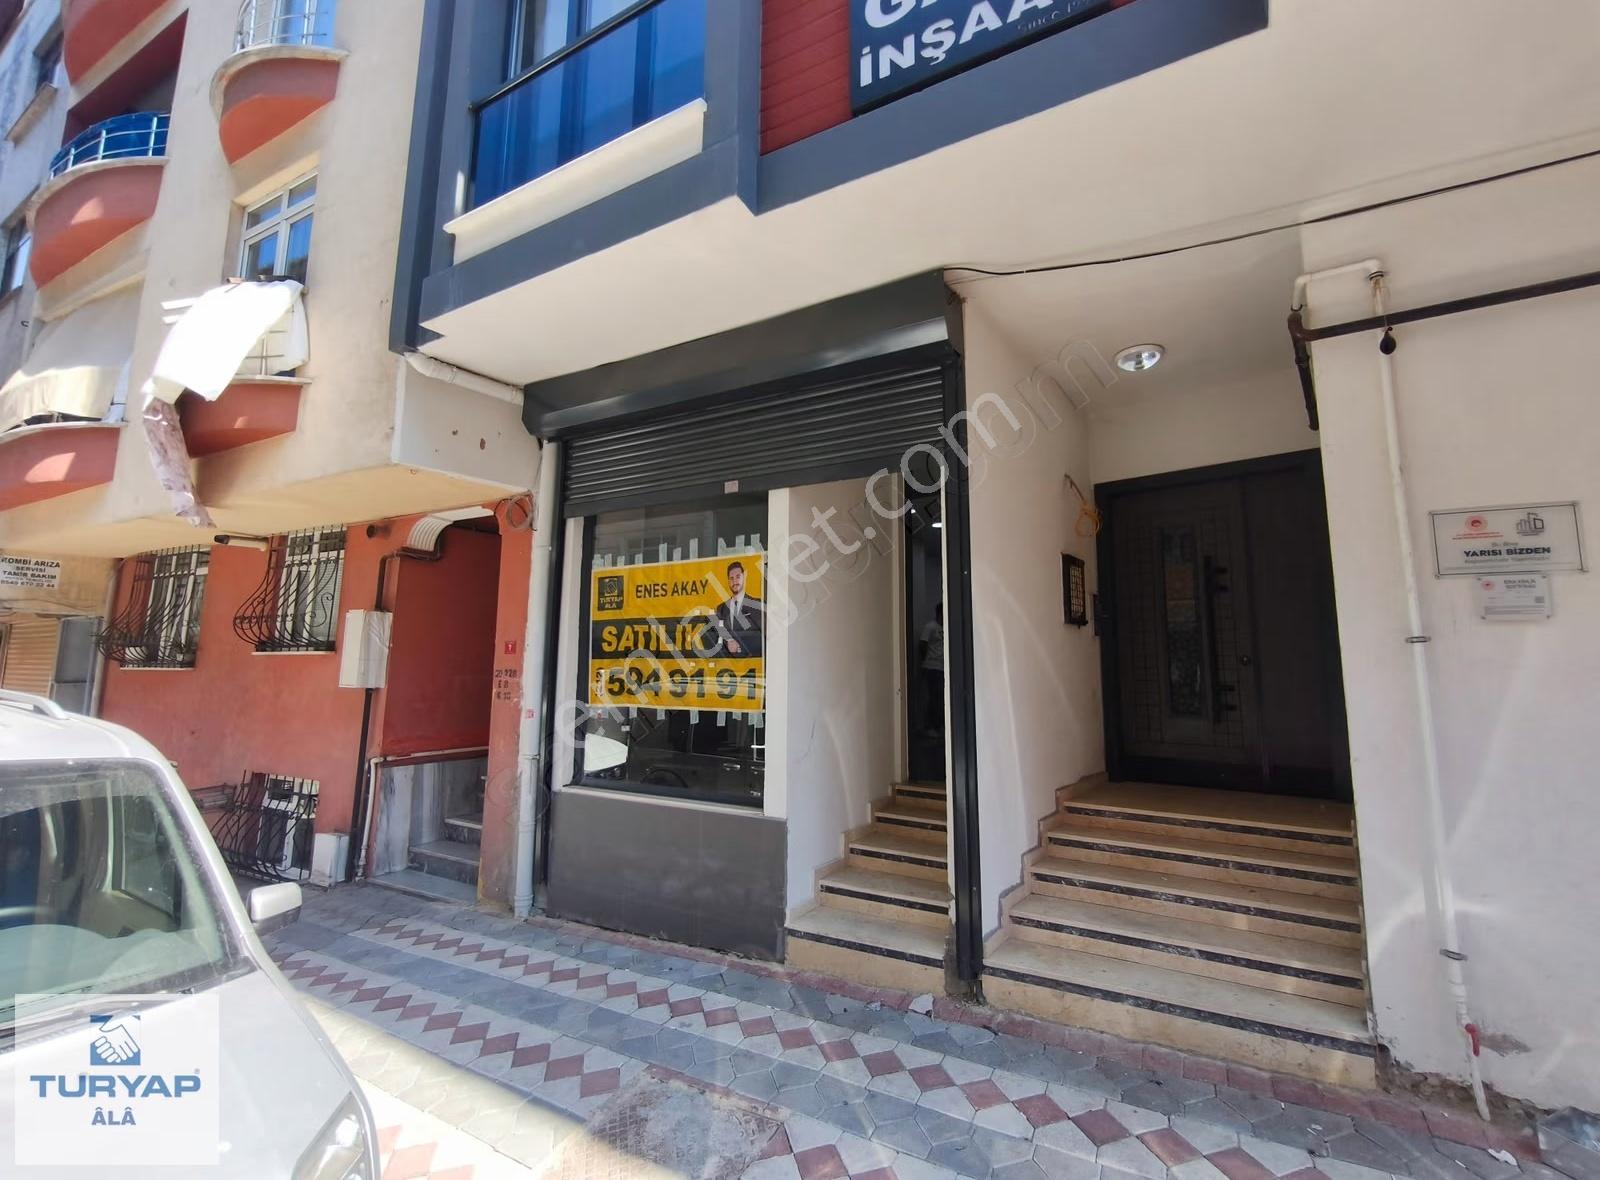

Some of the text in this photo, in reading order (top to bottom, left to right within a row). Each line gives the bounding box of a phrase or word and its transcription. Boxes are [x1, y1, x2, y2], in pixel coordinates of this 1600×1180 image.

[34, 560, 60, 568] ARIZA
[636, 580, 709, 599] ENES AKAY
[602, 623, 705, 652] SATILIK
